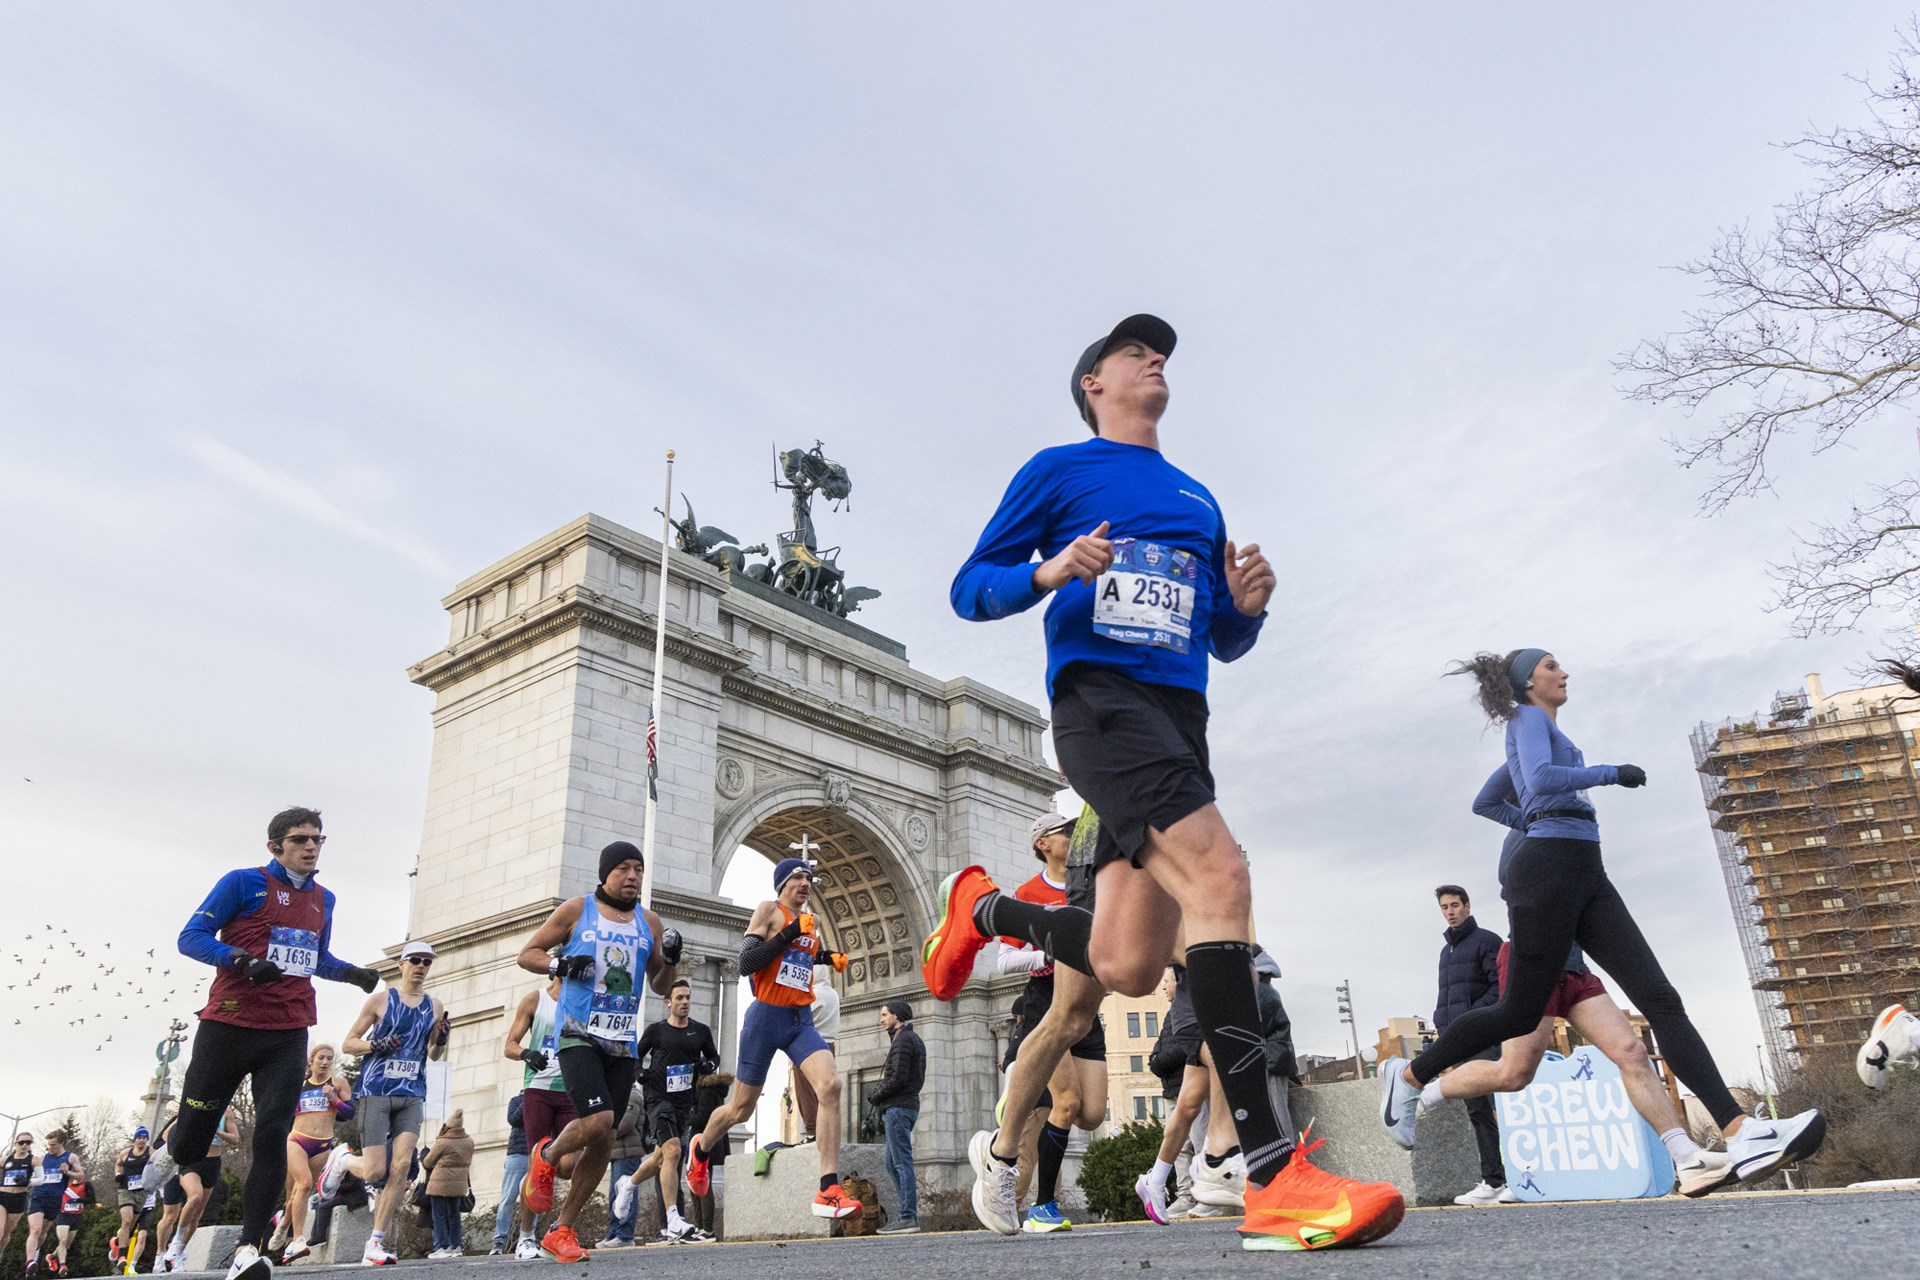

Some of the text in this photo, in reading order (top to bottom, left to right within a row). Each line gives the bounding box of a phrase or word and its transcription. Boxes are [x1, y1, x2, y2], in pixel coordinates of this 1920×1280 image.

[1102, 577, 1180, 613] A 2531
[1109, 628, 1171, 644] Bag Check 2531
[277, 890, 290, 899] LW
[278, 898, 290, 906] TC
[581, 930, 649, 951] GUATE
[269, 947, 311, 966] A 1636
[780, 964, 809, 982] A 5355
[590, 1014, 632, 1030] A 7647
[387, 1061, 416, 1073] A 7309
[668, 1077, 674, 1086] A
[1501, 1077, 1629, 1126] BREW
[1507, 1122, 1640, 1172] CHEW
